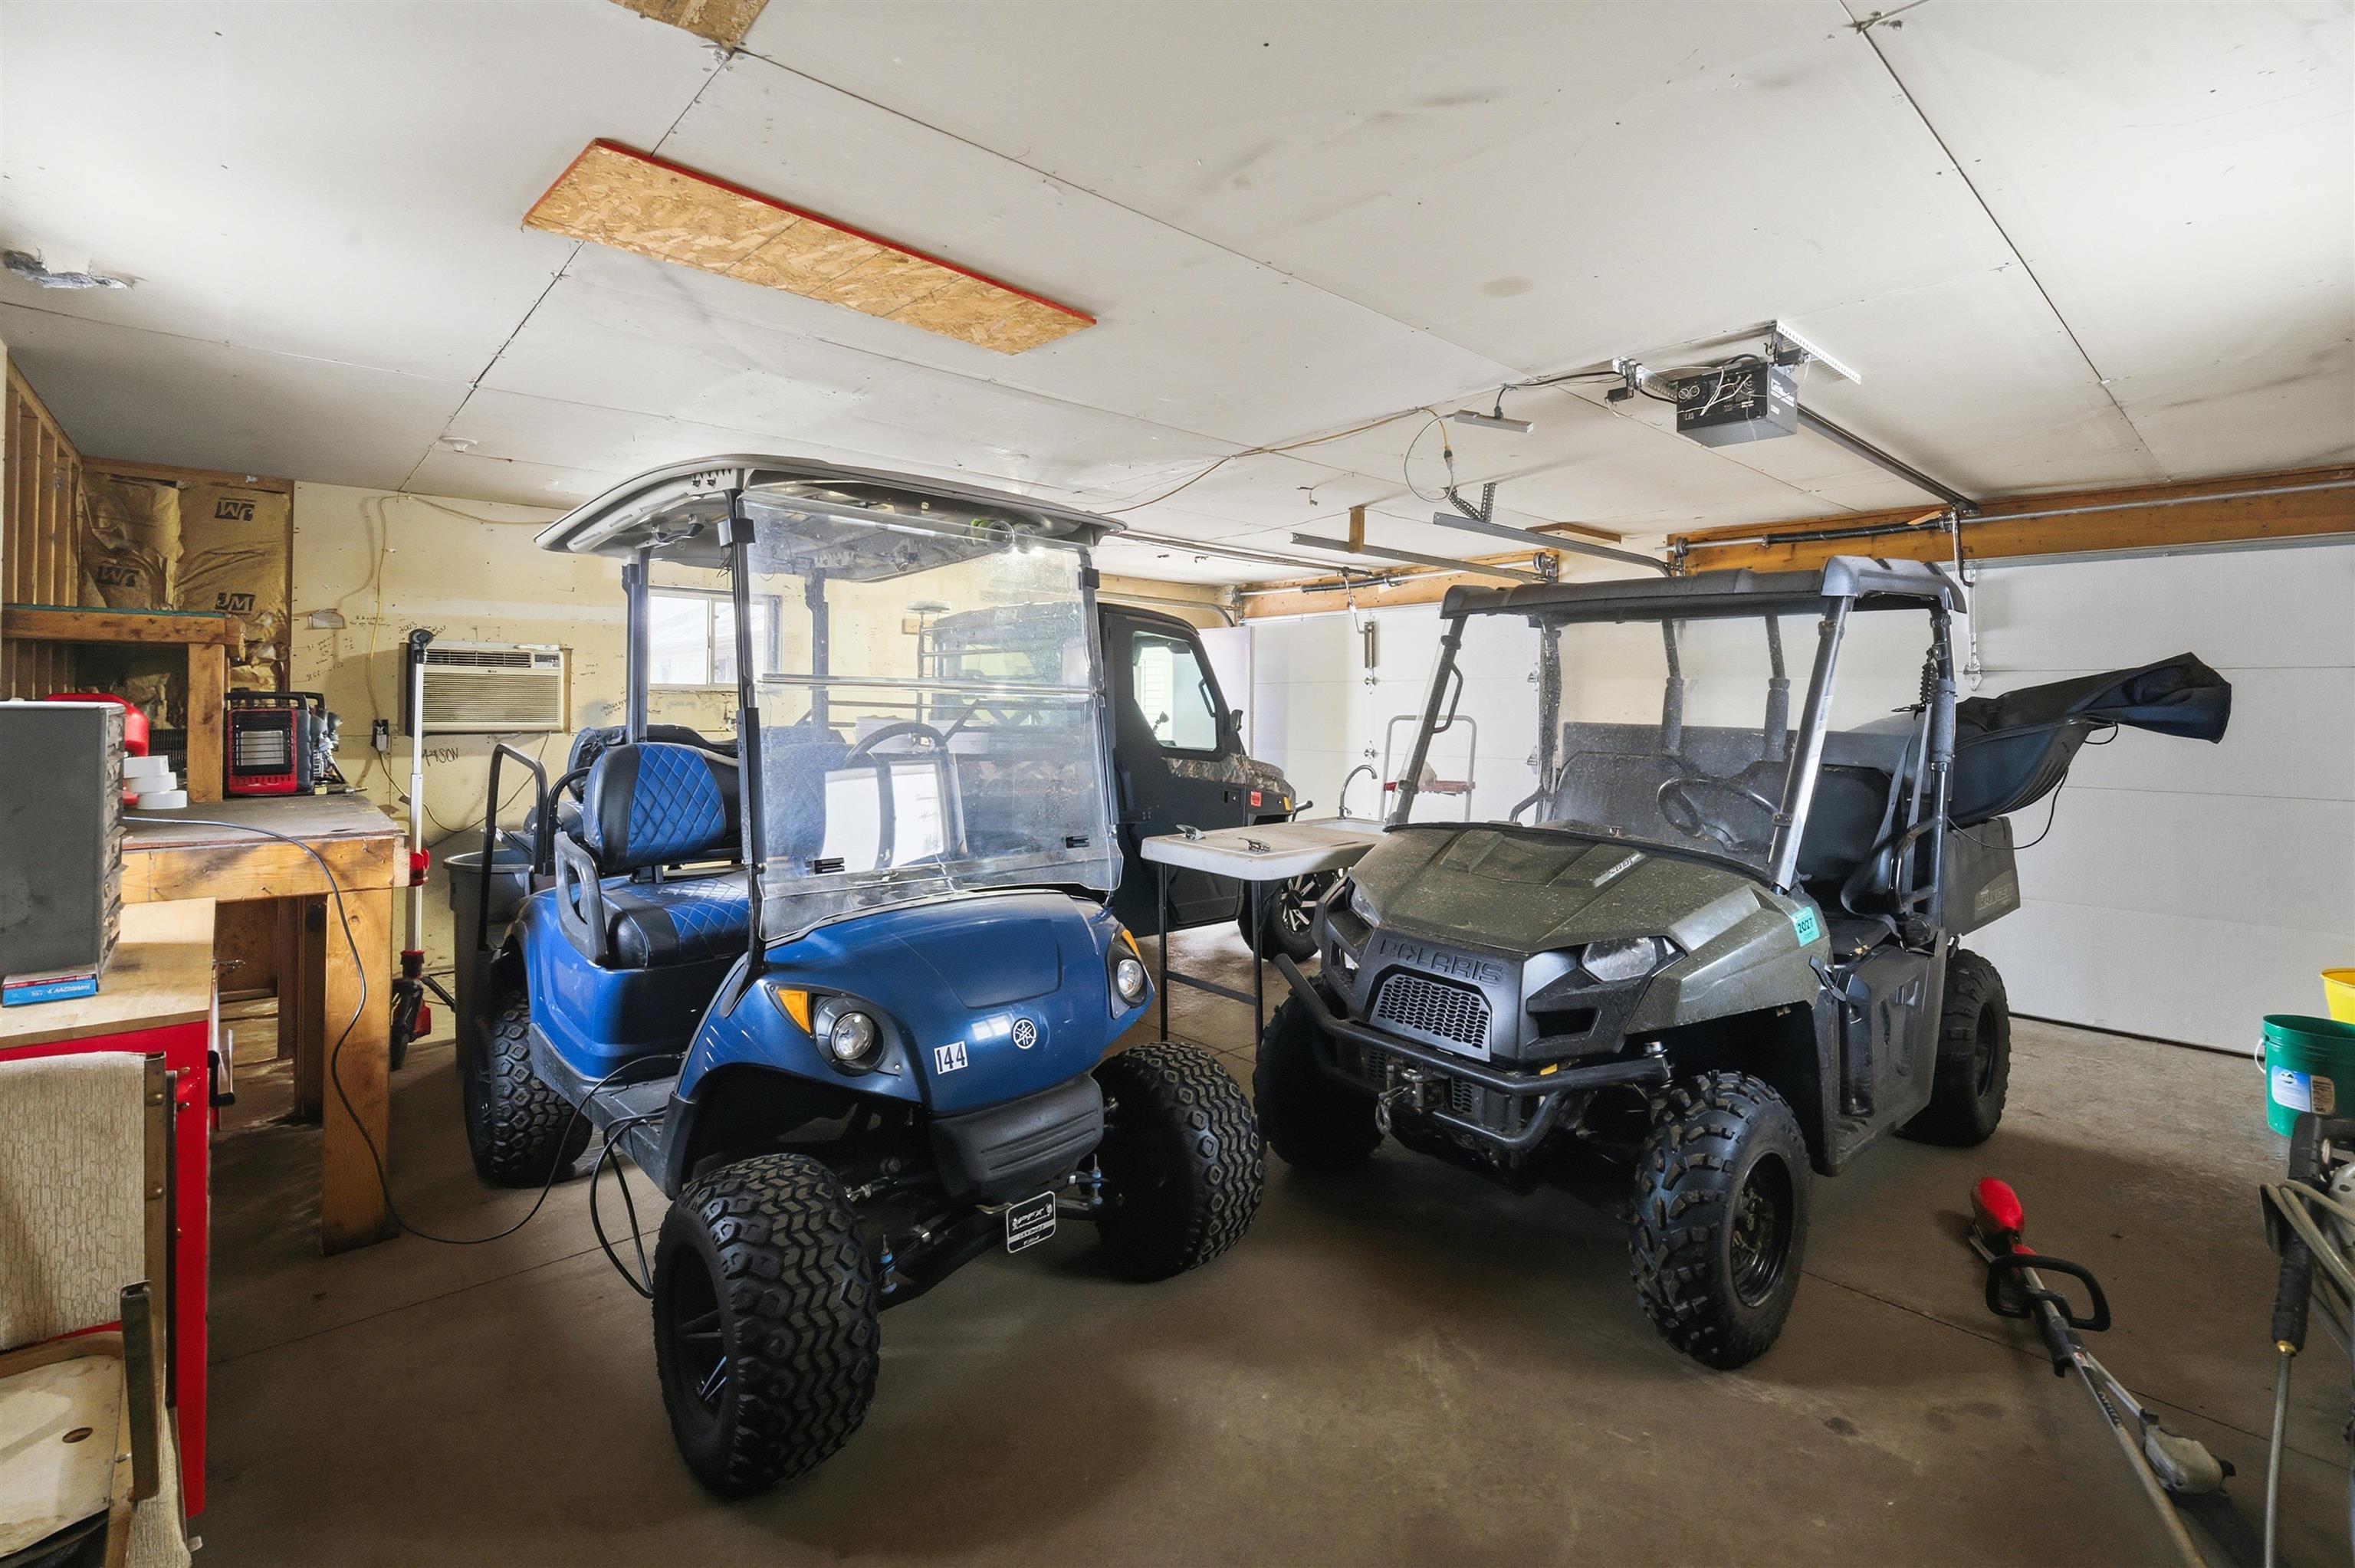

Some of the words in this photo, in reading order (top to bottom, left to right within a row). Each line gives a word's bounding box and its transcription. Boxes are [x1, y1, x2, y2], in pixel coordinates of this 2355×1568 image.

[217, 498, 255, 521] JM
[217, 592, 255, 612] JM
[1797, 917, 1813, 933] 2027
[1378, 938, 1505, 986] POLARIS
[936, 1043, 966, 1073] 144
